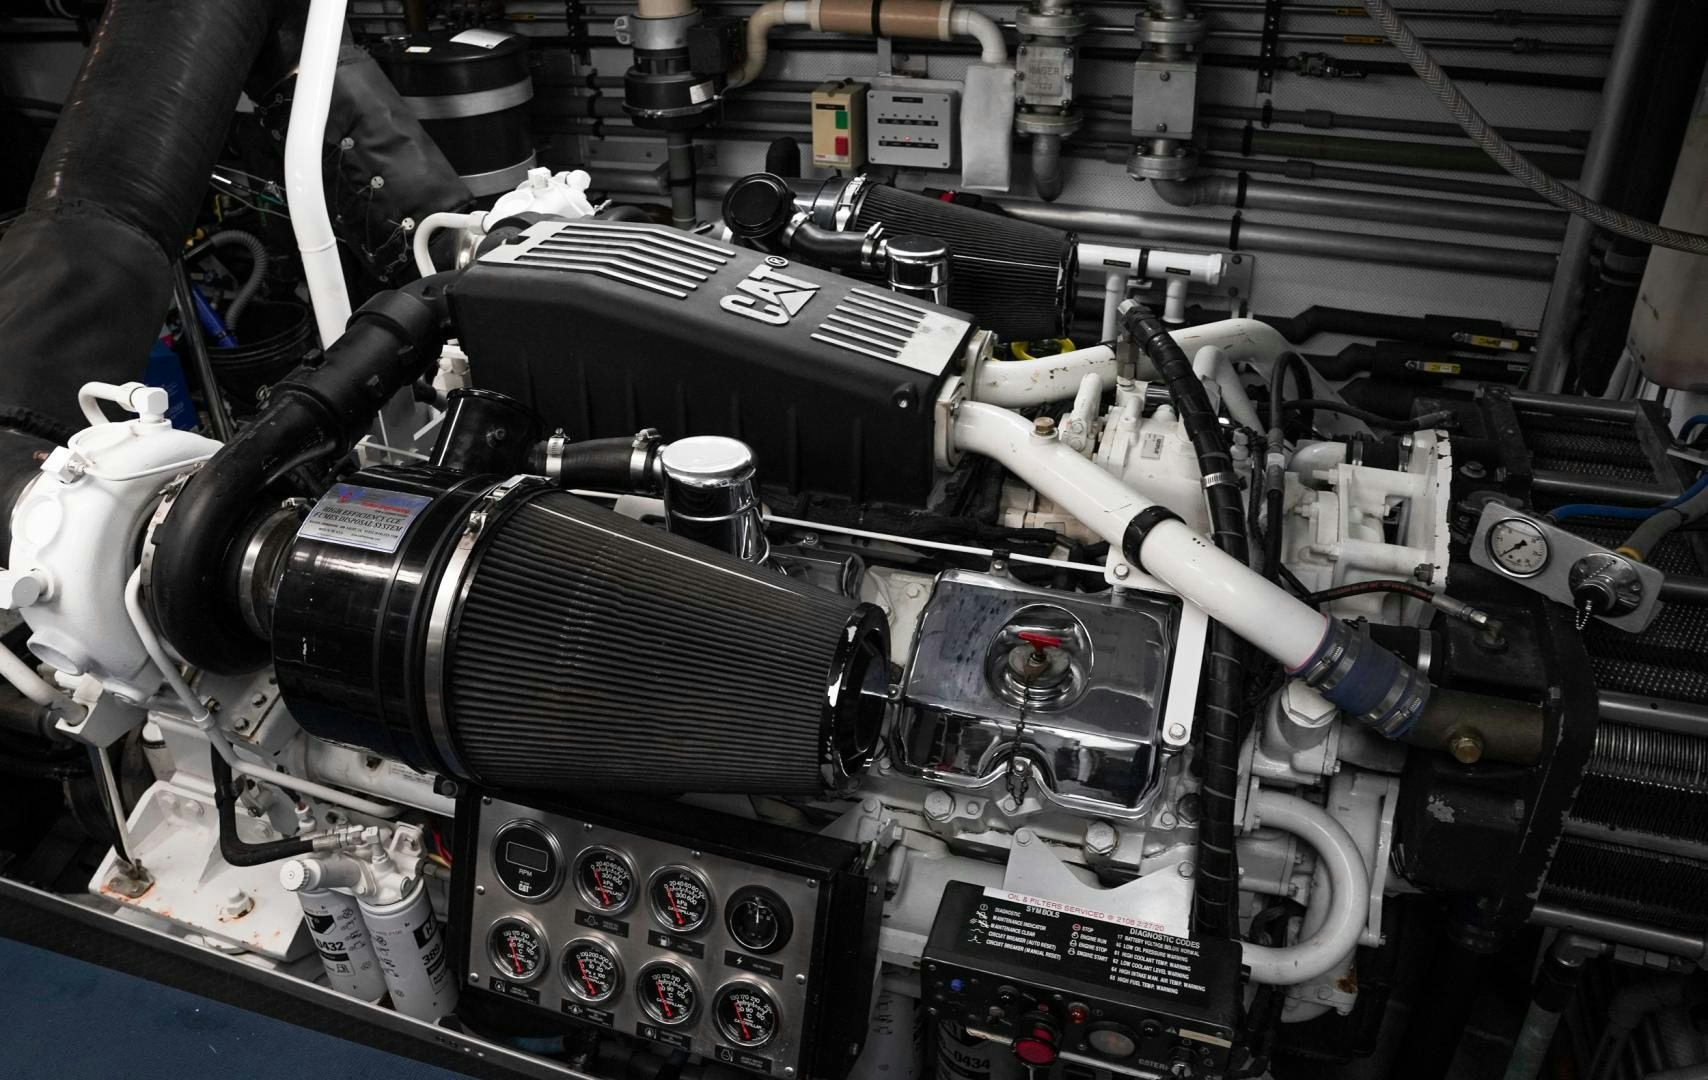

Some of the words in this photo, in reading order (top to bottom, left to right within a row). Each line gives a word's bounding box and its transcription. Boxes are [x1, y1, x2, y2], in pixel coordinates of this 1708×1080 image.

[720, 264, 821, 326] CAT
[519, 868, 533, 876] RPM
[1026, 906, 1060, 919] SYMBOLS
[1030, 898, 1062, 910] FILTERS
[1064, 905, 1105, 919] SERVICED
[1130, 928, 1174, 944] DIAGNOSTIC
[1176, 938, 1200, 949] CODES
[1134, 954, 1155, 963] COOLANT
[1132, 963, 1153, 971] COOLANT
[1156, 985, 1178, 994] WARNING
[1183, 982, 1206, 992] WARNING
